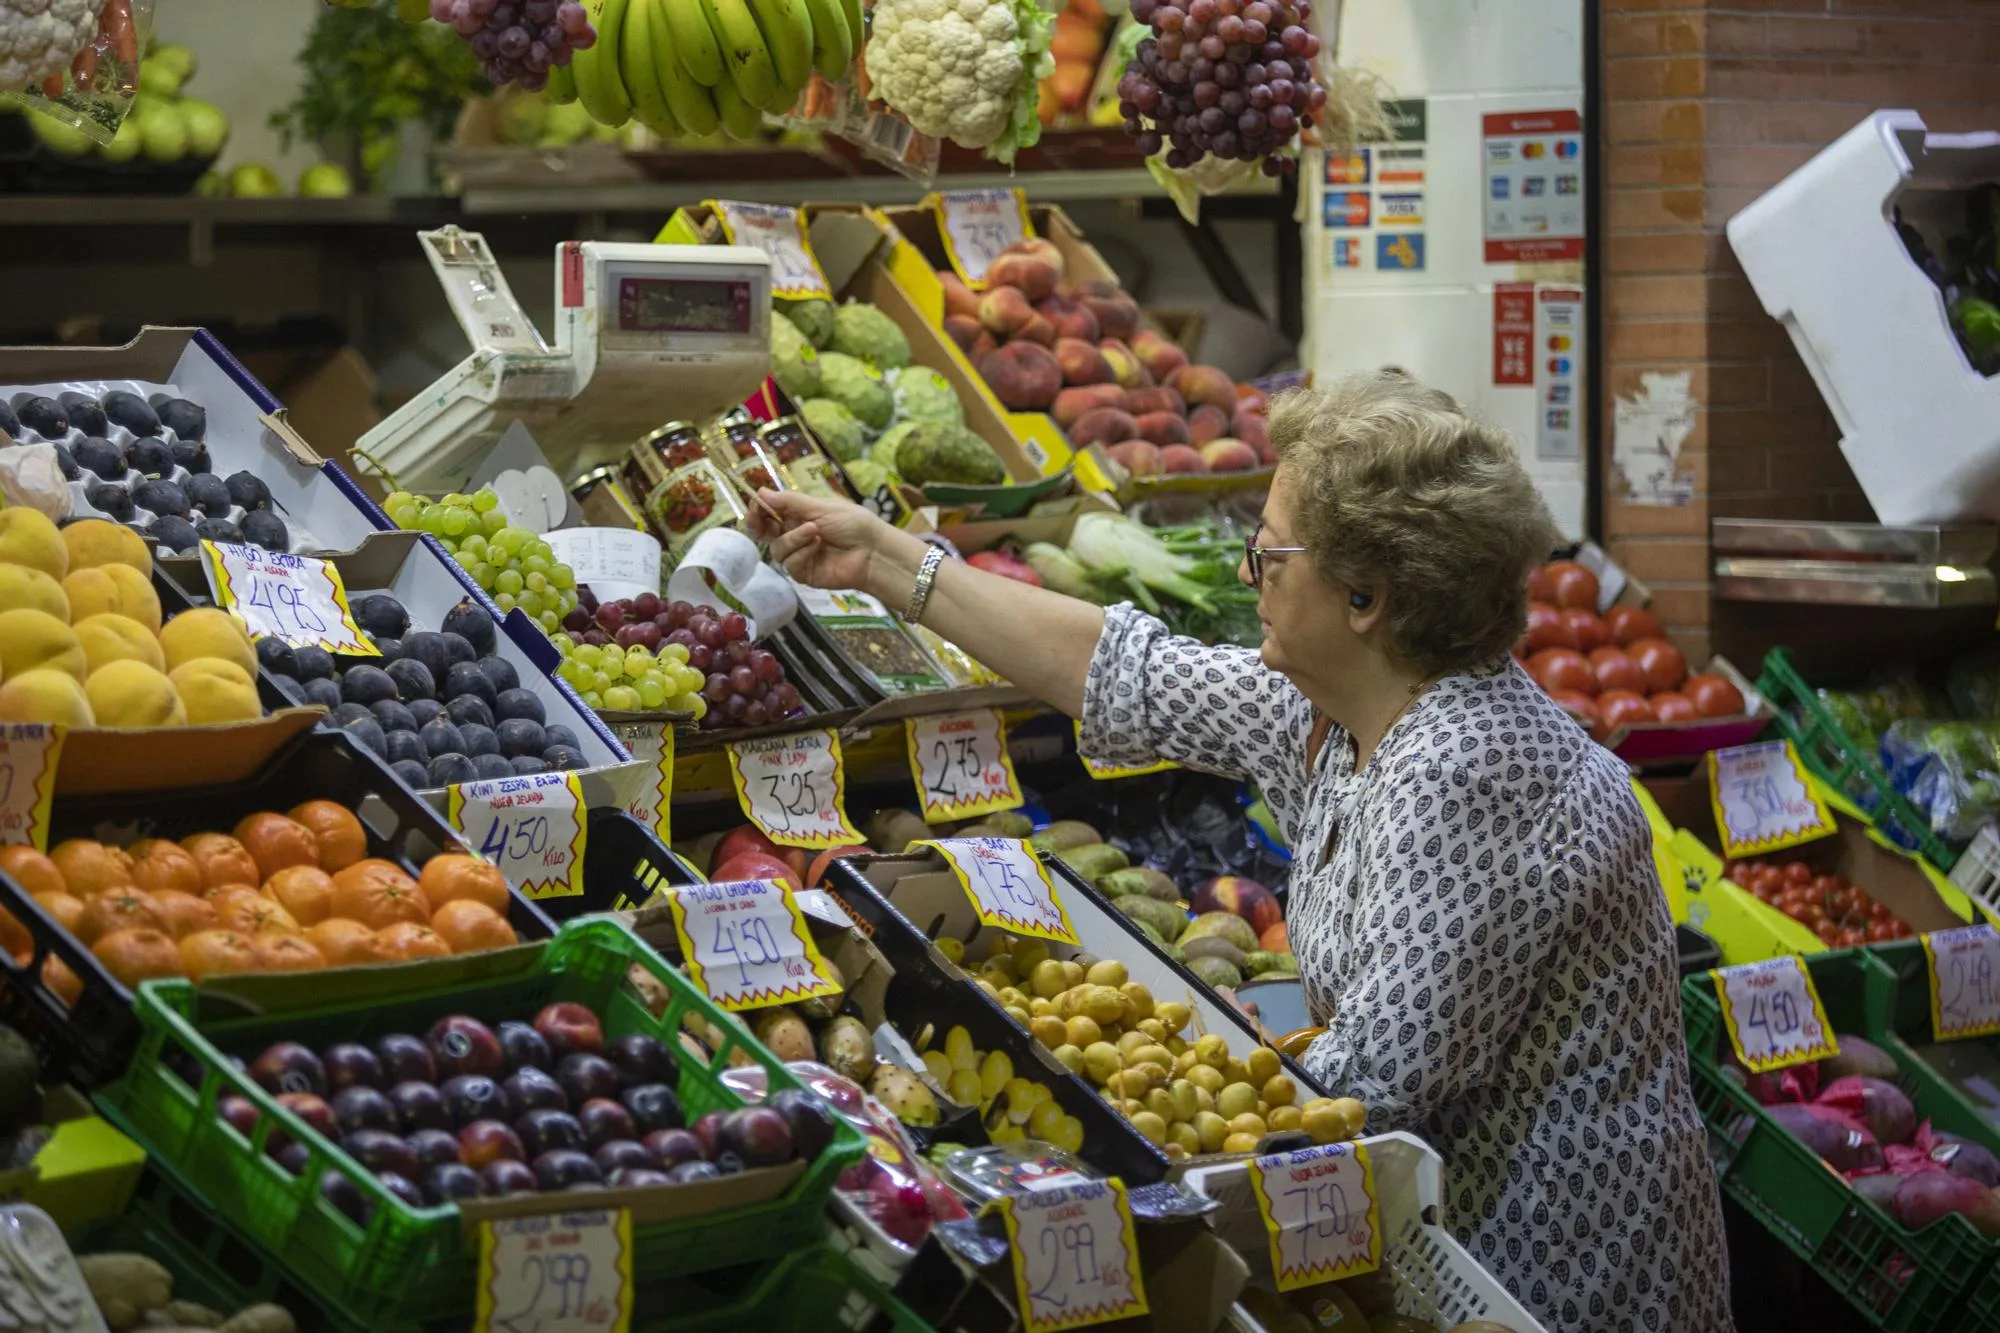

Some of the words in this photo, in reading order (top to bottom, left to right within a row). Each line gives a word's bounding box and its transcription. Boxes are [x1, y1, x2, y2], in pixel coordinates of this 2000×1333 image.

[227, 544, 262, 563] HIGO
[269, 551, 307, 571] EXTRA
[249, 575, 327, 638] 4'95
[739, 739, 788, 754] MANZANA
[794, 736, 823, 750] EXTRA
[758, 753, 783, 767] PINK
[786, 751, 809, 766] LADY
[928, 736, 982, 796] 2'75
[470, 782, 494, 799] KIWI
[497, 778, 532, 793] ZESPRI
[534, 774, 563, 788] EXTRA
[759, 769, 817, 833] 3'25
[480, 815, 549, 867] 4'50
[542, 845, 566, 867] KILO
[687, 884, 723, 905] HIGO
[725, 879, 769, 901] CHUMBO
[713, 916, 782, 987] 4'50
[781, 956, 806, 979] KILO
[1747, 990, 1799, 1053] 4'50
[1282, 1182, 1350, 1264] 7'50
[1028, 1222, 1101, 1308] 2'99
